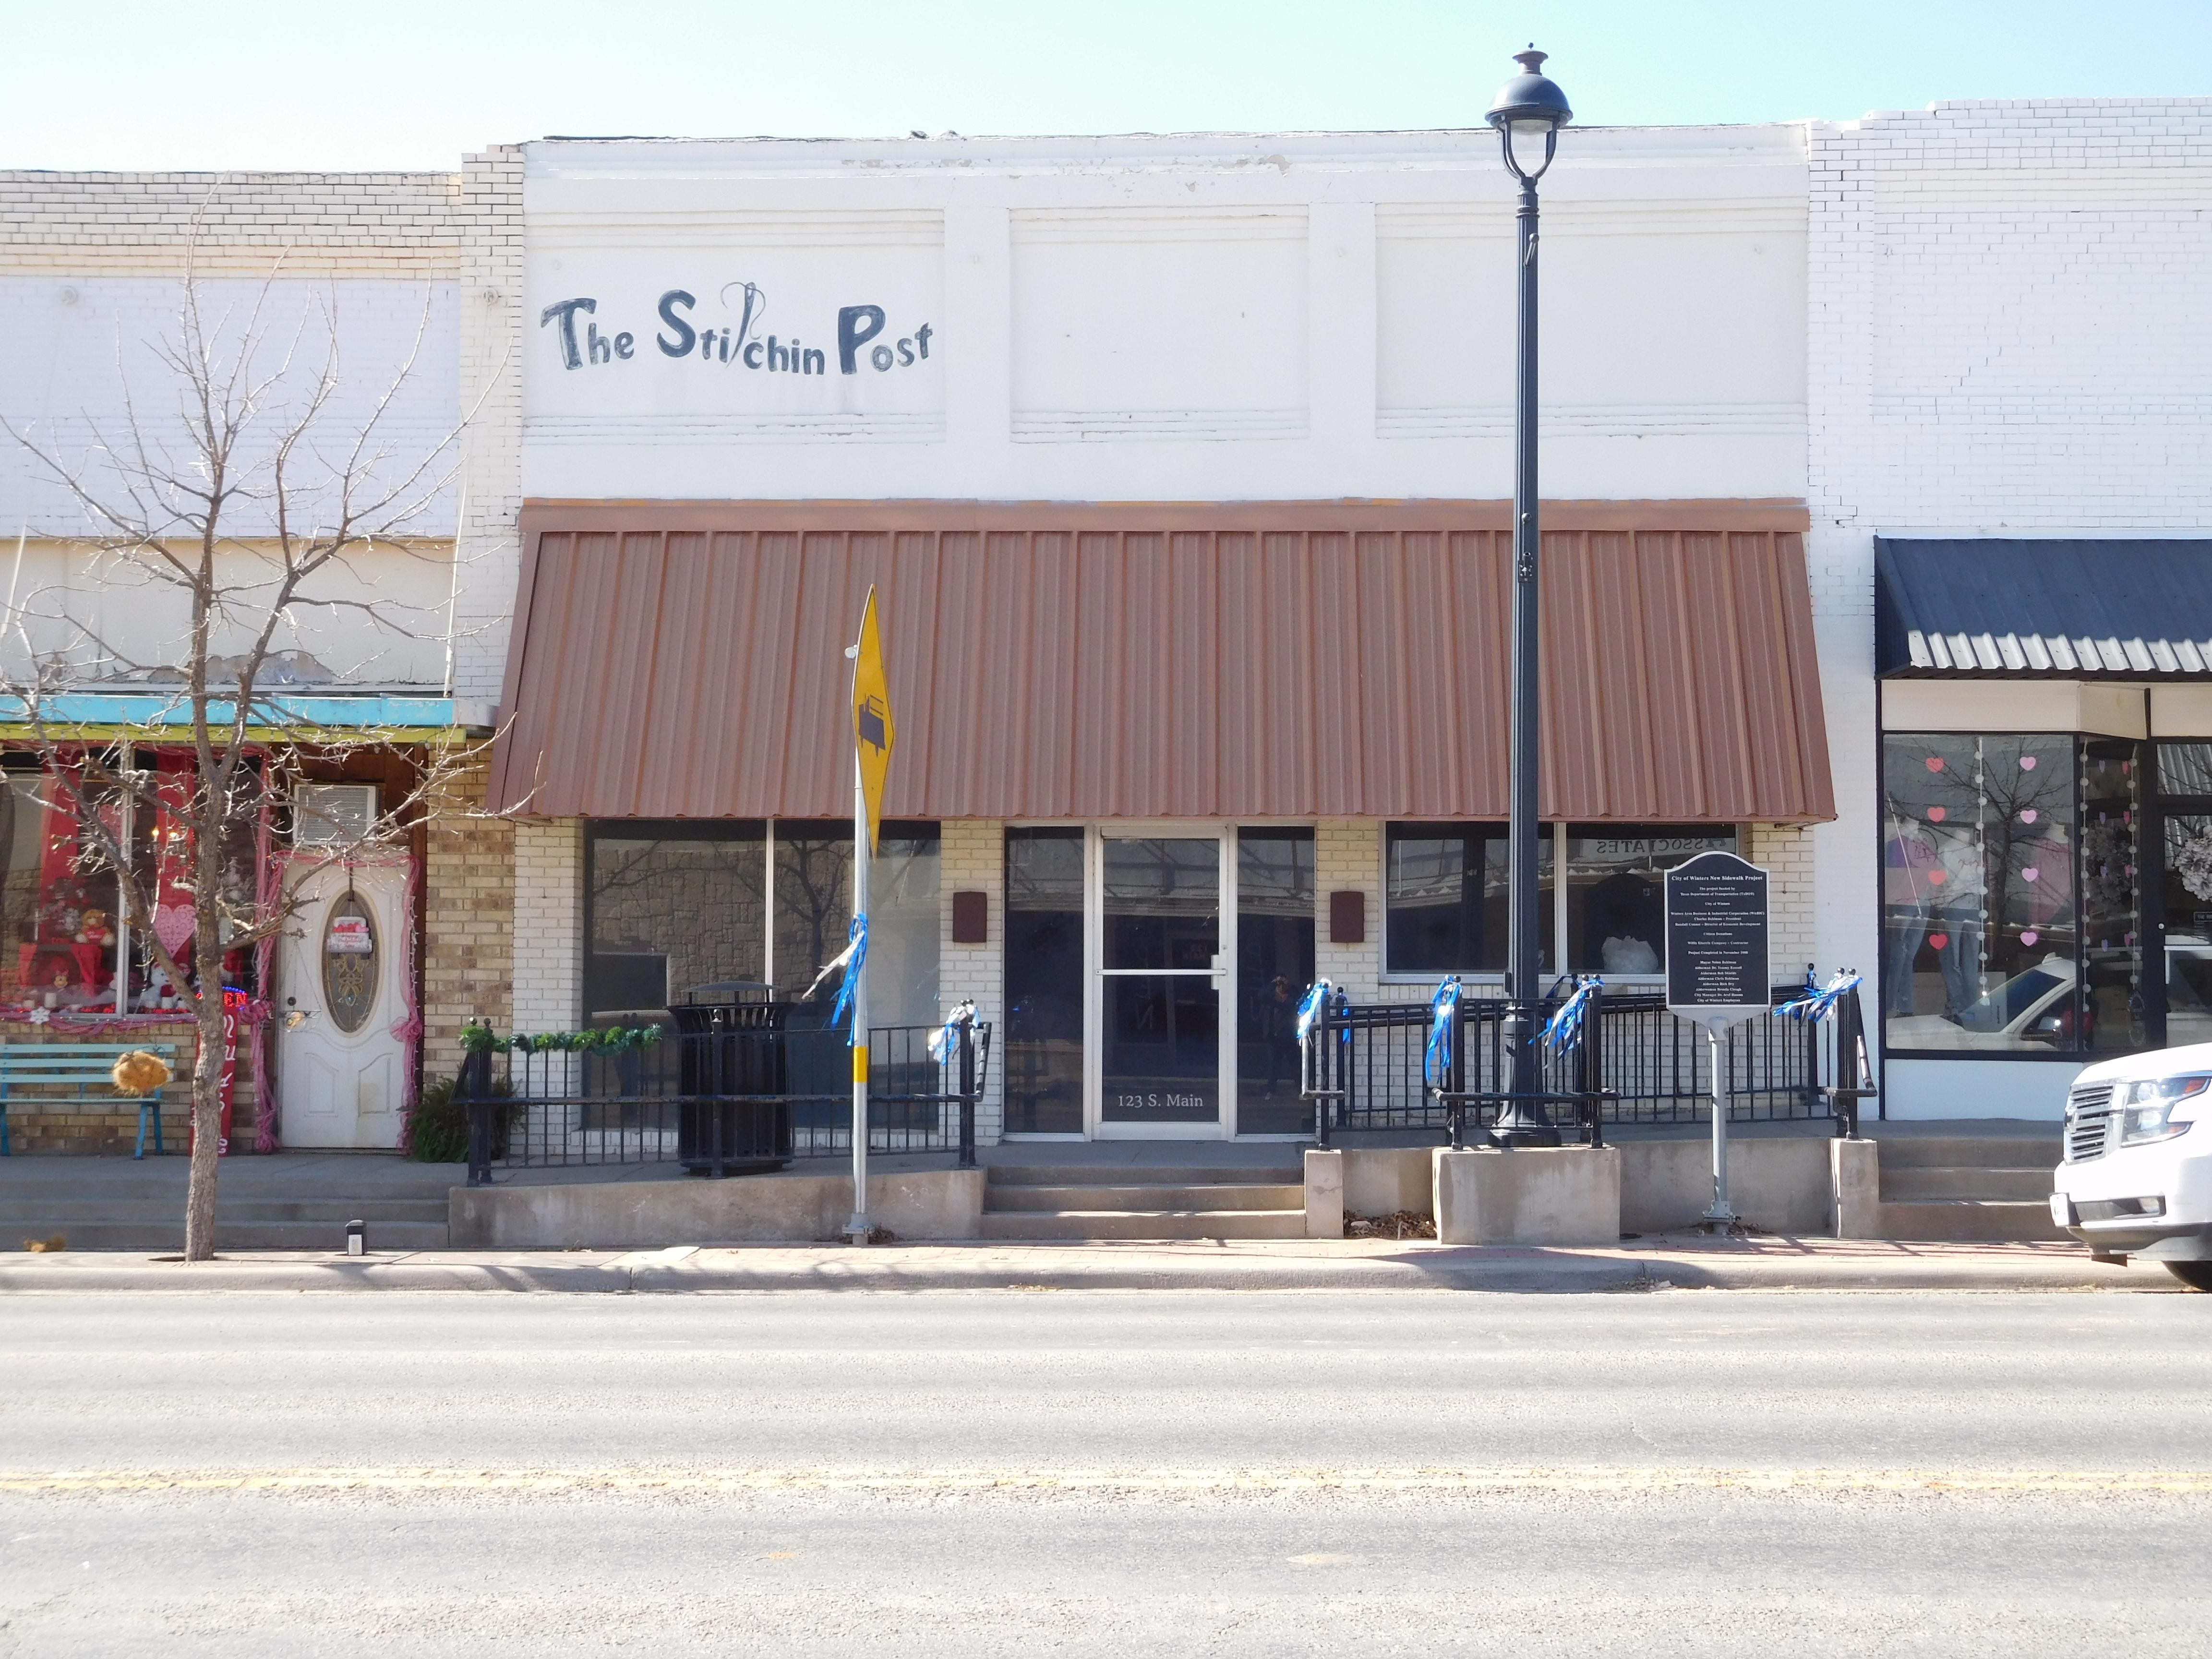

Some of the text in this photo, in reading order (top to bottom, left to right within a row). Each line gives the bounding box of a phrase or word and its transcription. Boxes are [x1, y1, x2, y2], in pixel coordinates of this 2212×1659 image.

[541, 298, 634, 370] The
[838, 304, 933, 374] Post
[1118, 1094, 1203, 1108] 123 S. Main
